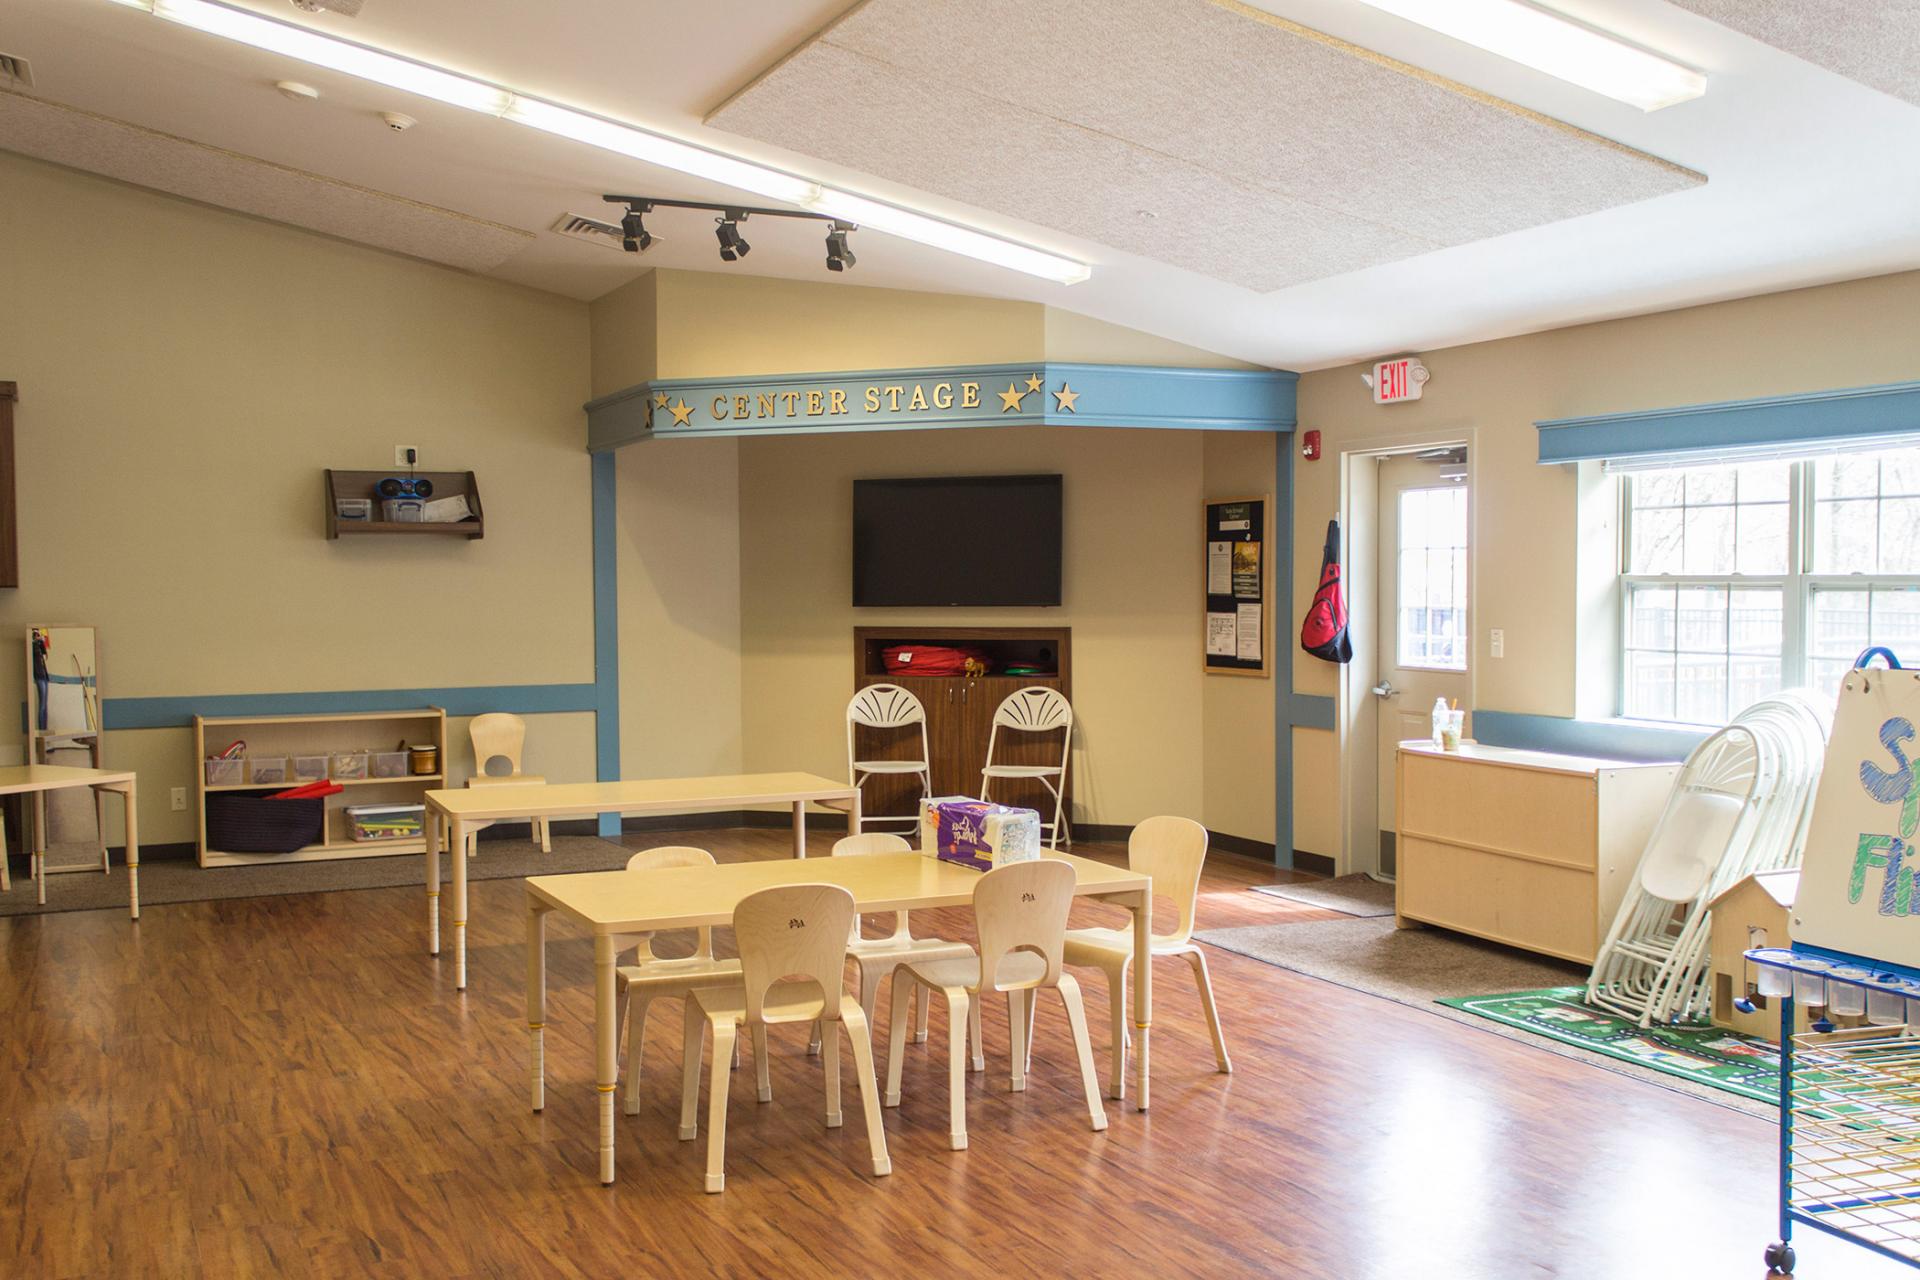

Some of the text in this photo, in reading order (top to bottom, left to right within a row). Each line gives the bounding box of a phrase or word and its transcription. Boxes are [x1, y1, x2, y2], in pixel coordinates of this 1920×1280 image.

[1381, 361, 1408, 400] EXIT
[710, 382, 981, 421] CENTER STAGE
